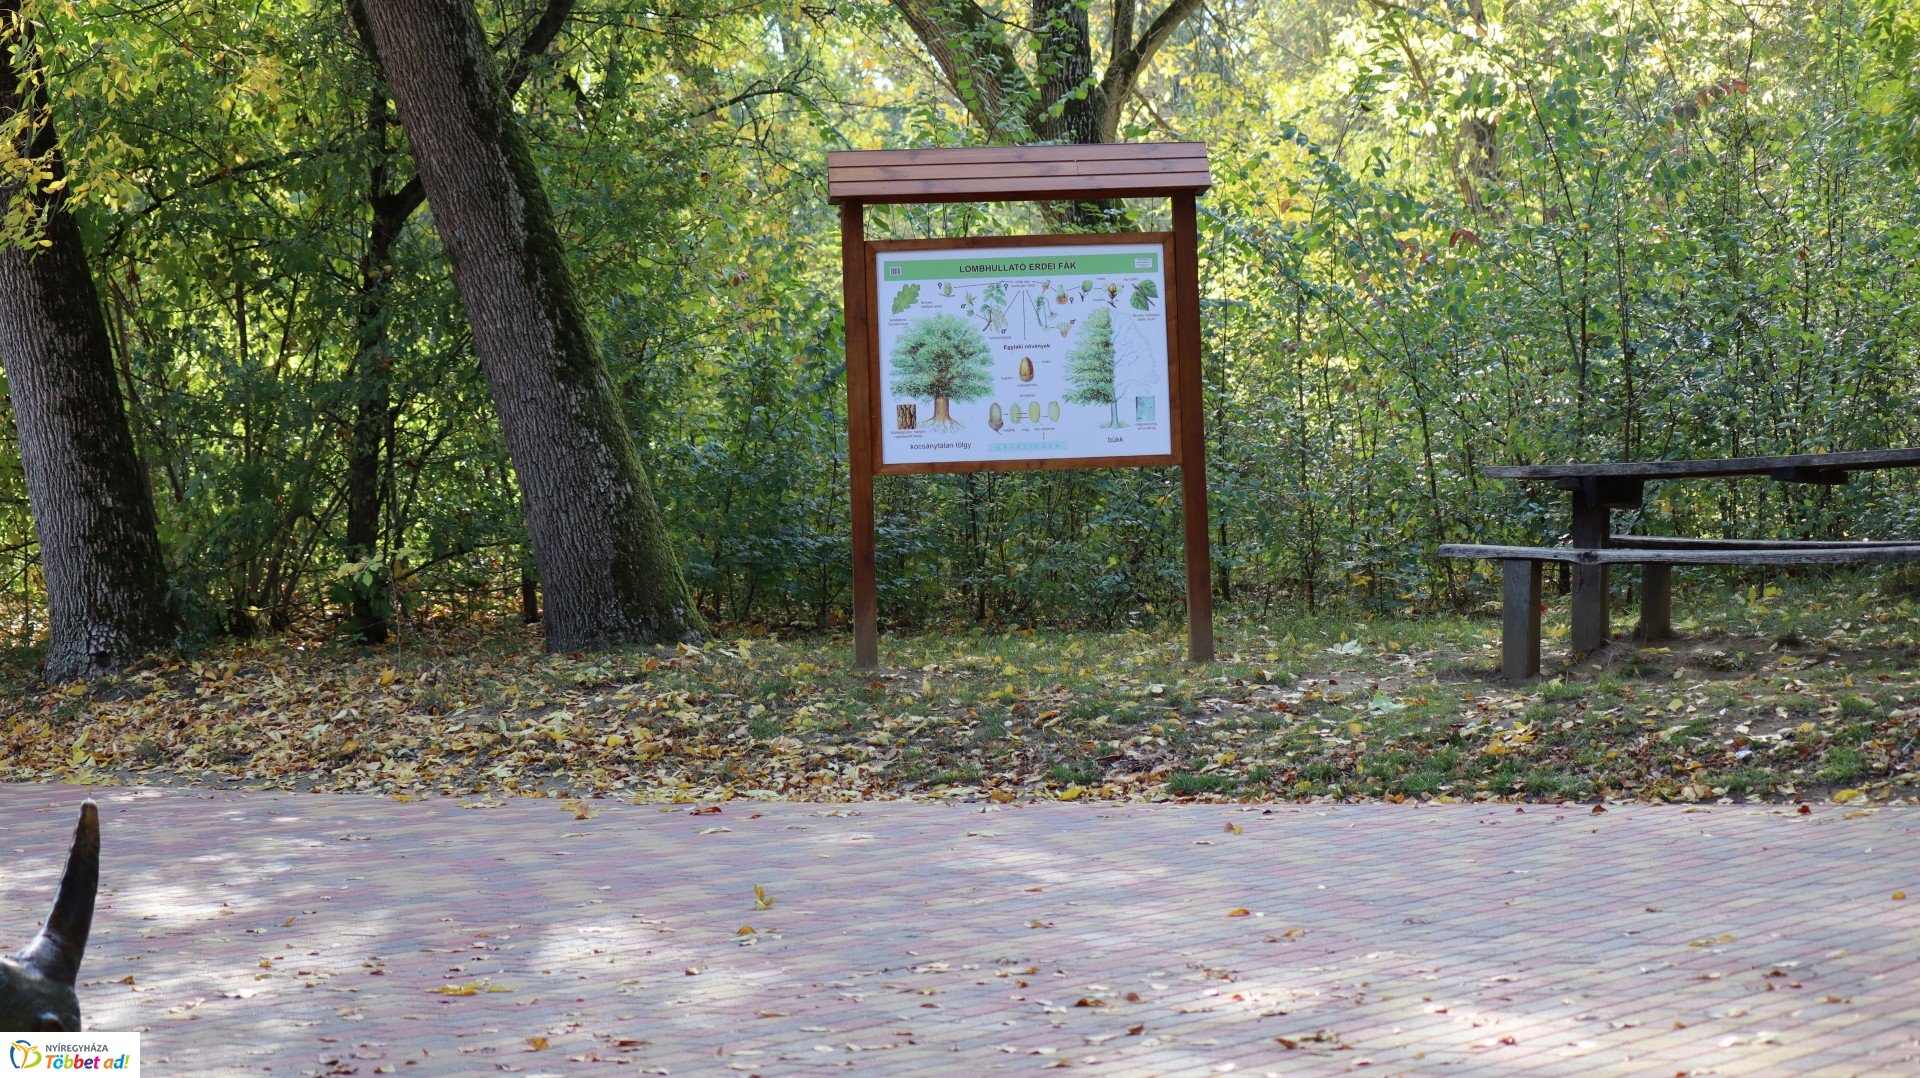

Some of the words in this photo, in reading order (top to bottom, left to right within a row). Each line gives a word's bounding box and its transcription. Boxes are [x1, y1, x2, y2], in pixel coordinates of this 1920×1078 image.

[959, 262, 1027, 273] LOMBHULLATÓ
[1029, 262, 1056, 271] ERDEI
[1058, 261, 1077, 270] FÁK
